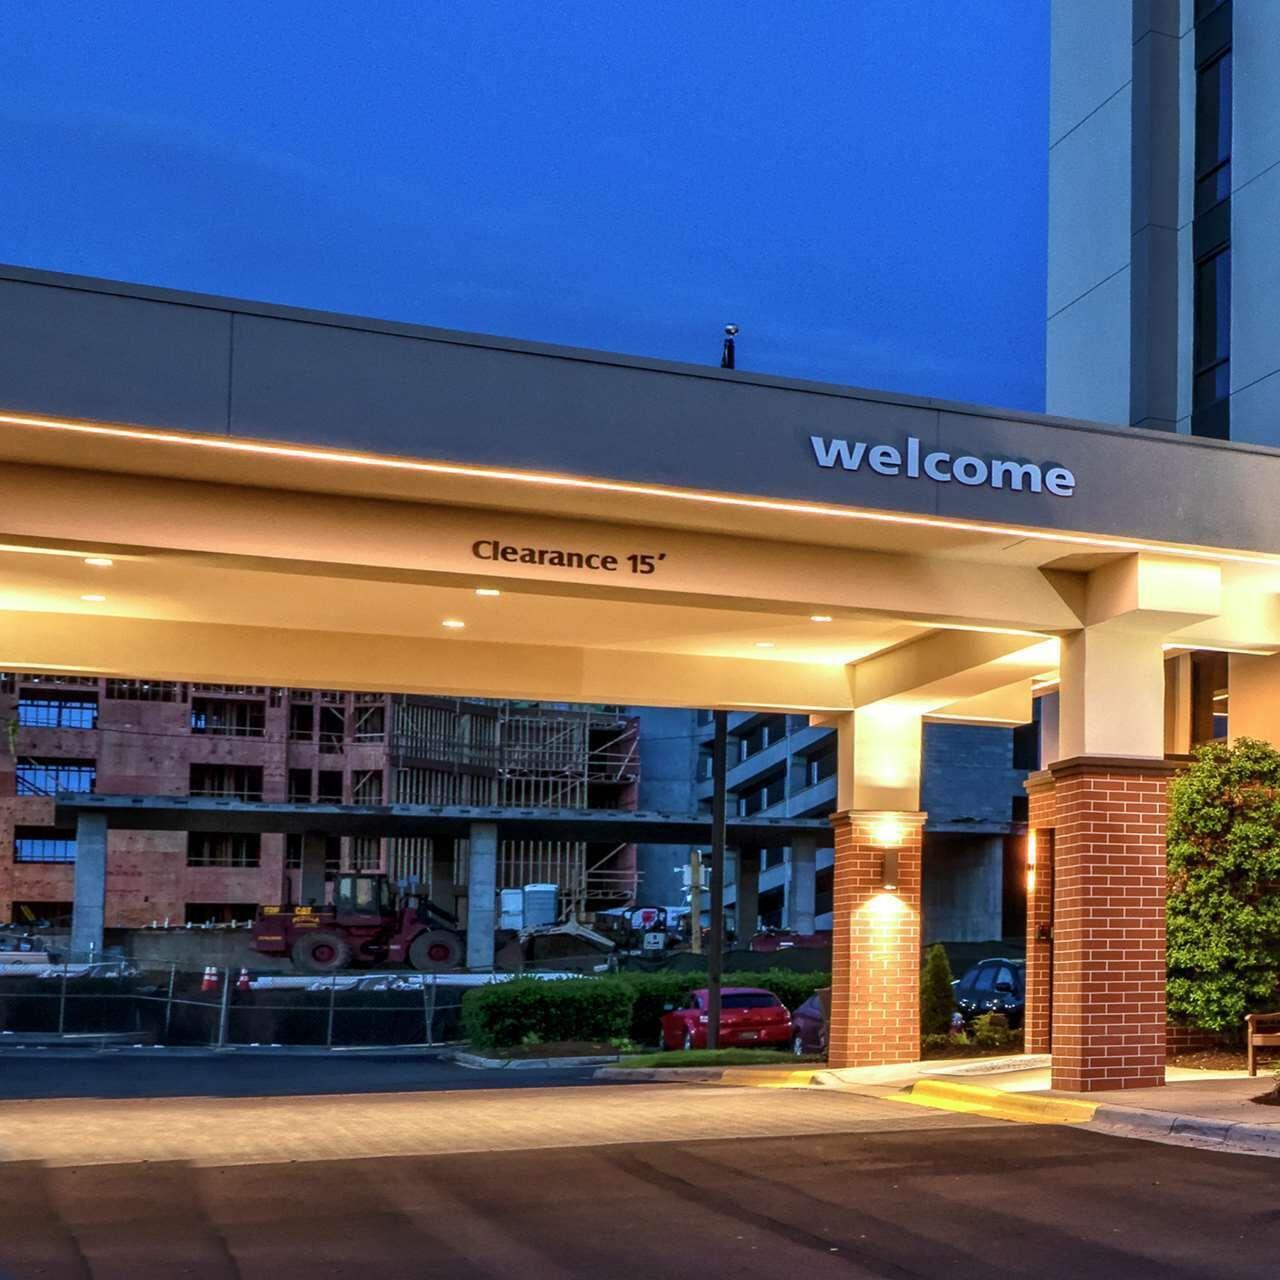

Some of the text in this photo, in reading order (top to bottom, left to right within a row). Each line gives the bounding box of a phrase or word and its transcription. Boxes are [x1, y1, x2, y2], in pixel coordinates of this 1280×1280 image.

[810, 436, 1076, 497] welcome
[472, 540, 667, 575] Clearance 15'
